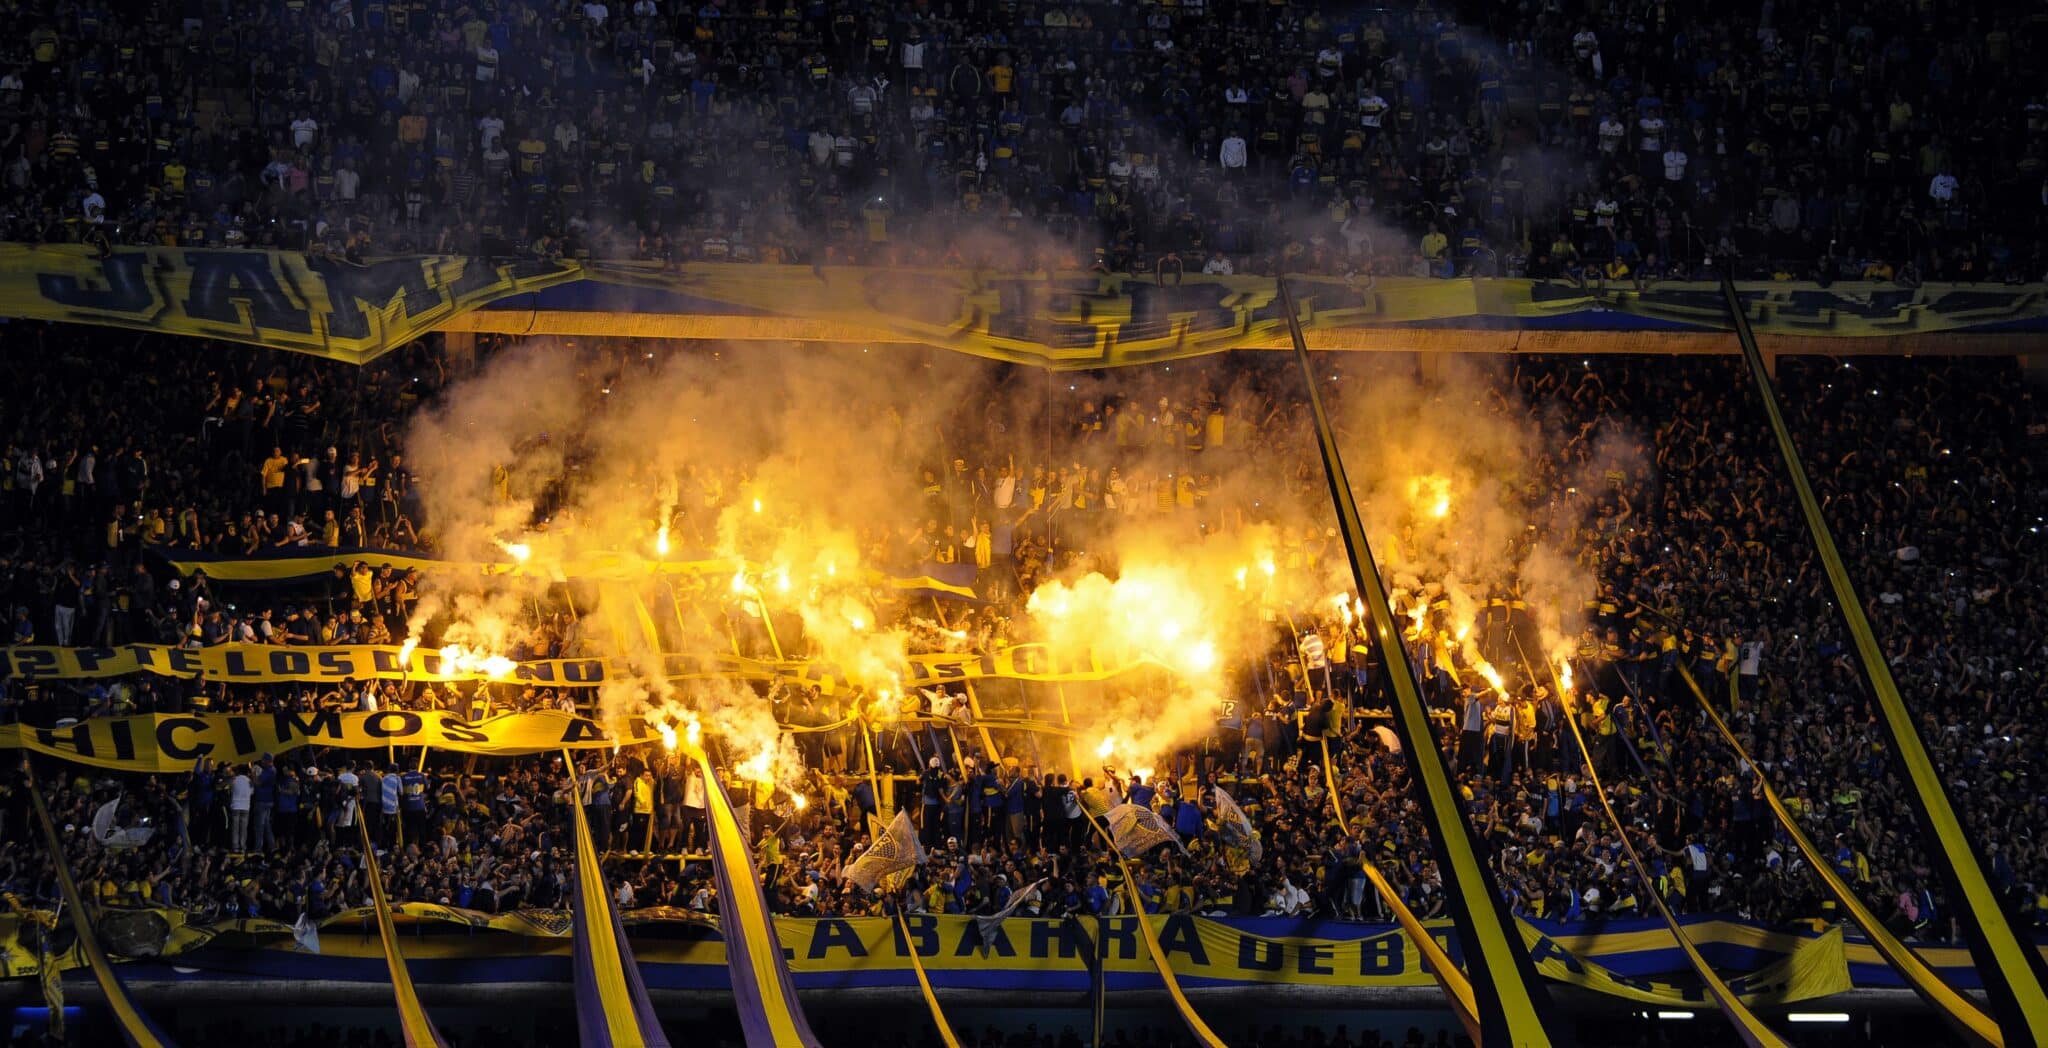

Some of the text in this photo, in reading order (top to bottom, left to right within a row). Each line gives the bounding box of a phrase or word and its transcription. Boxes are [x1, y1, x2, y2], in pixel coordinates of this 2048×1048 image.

[37, 711, 489, 759] HICIMOS
[783, 918, 867, 959] A
[1239, 935, 1333, 975] DE
